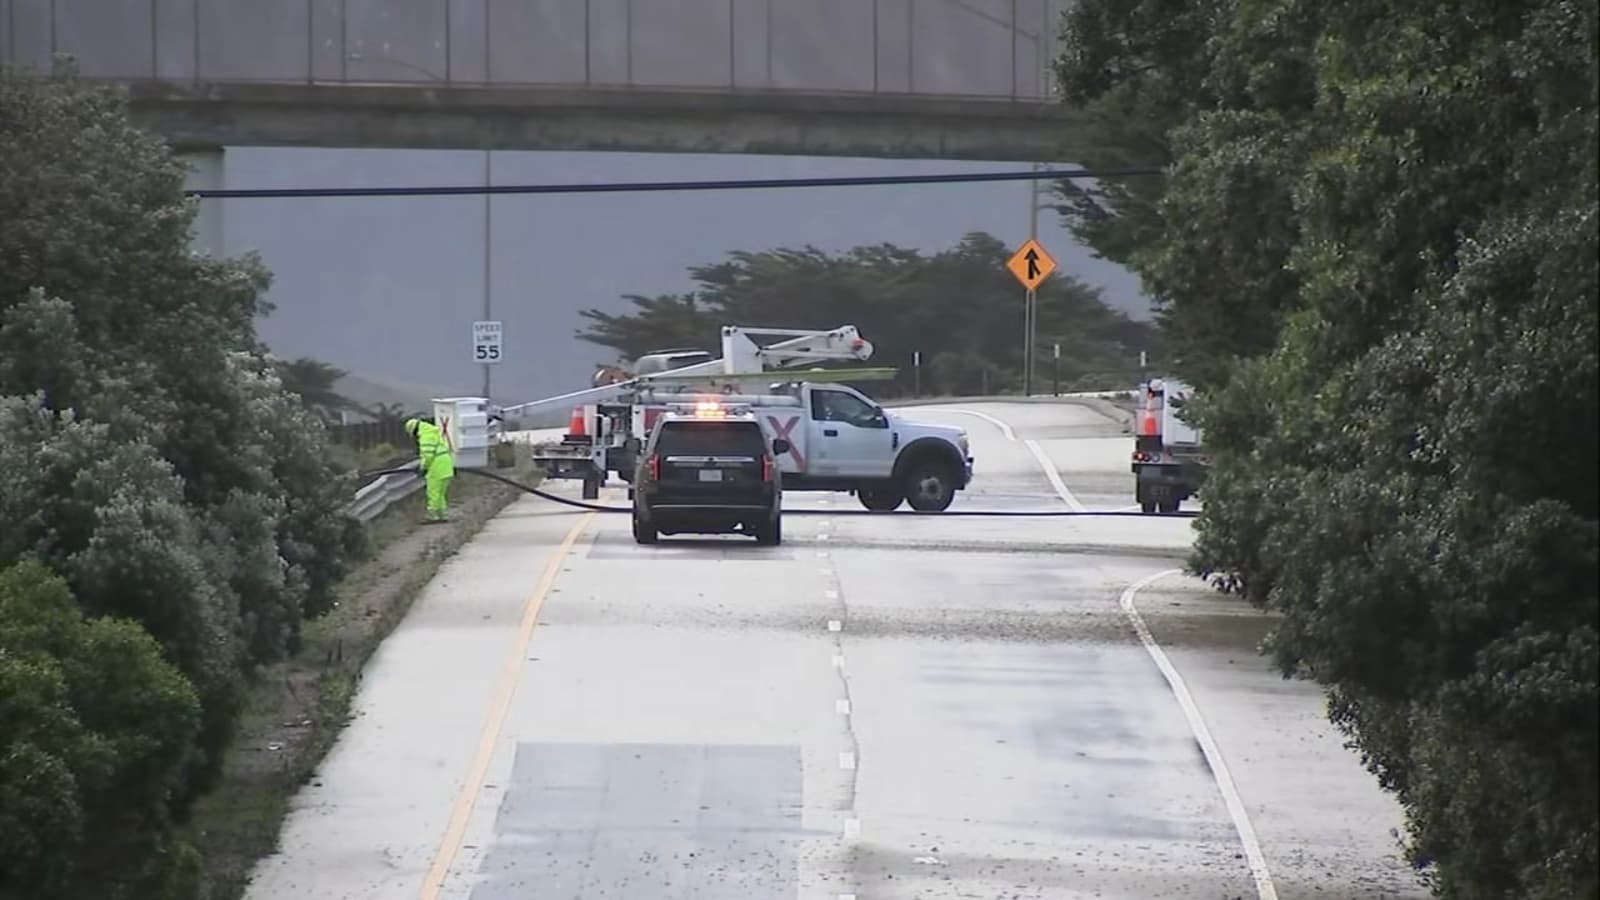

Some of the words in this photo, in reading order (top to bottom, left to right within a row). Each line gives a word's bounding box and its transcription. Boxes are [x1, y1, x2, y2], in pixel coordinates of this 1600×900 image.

[474, 323, 500, 332] SPEED
[476, 333, 498, 342] LIMIT
[476, 345, 499, 360] 55
